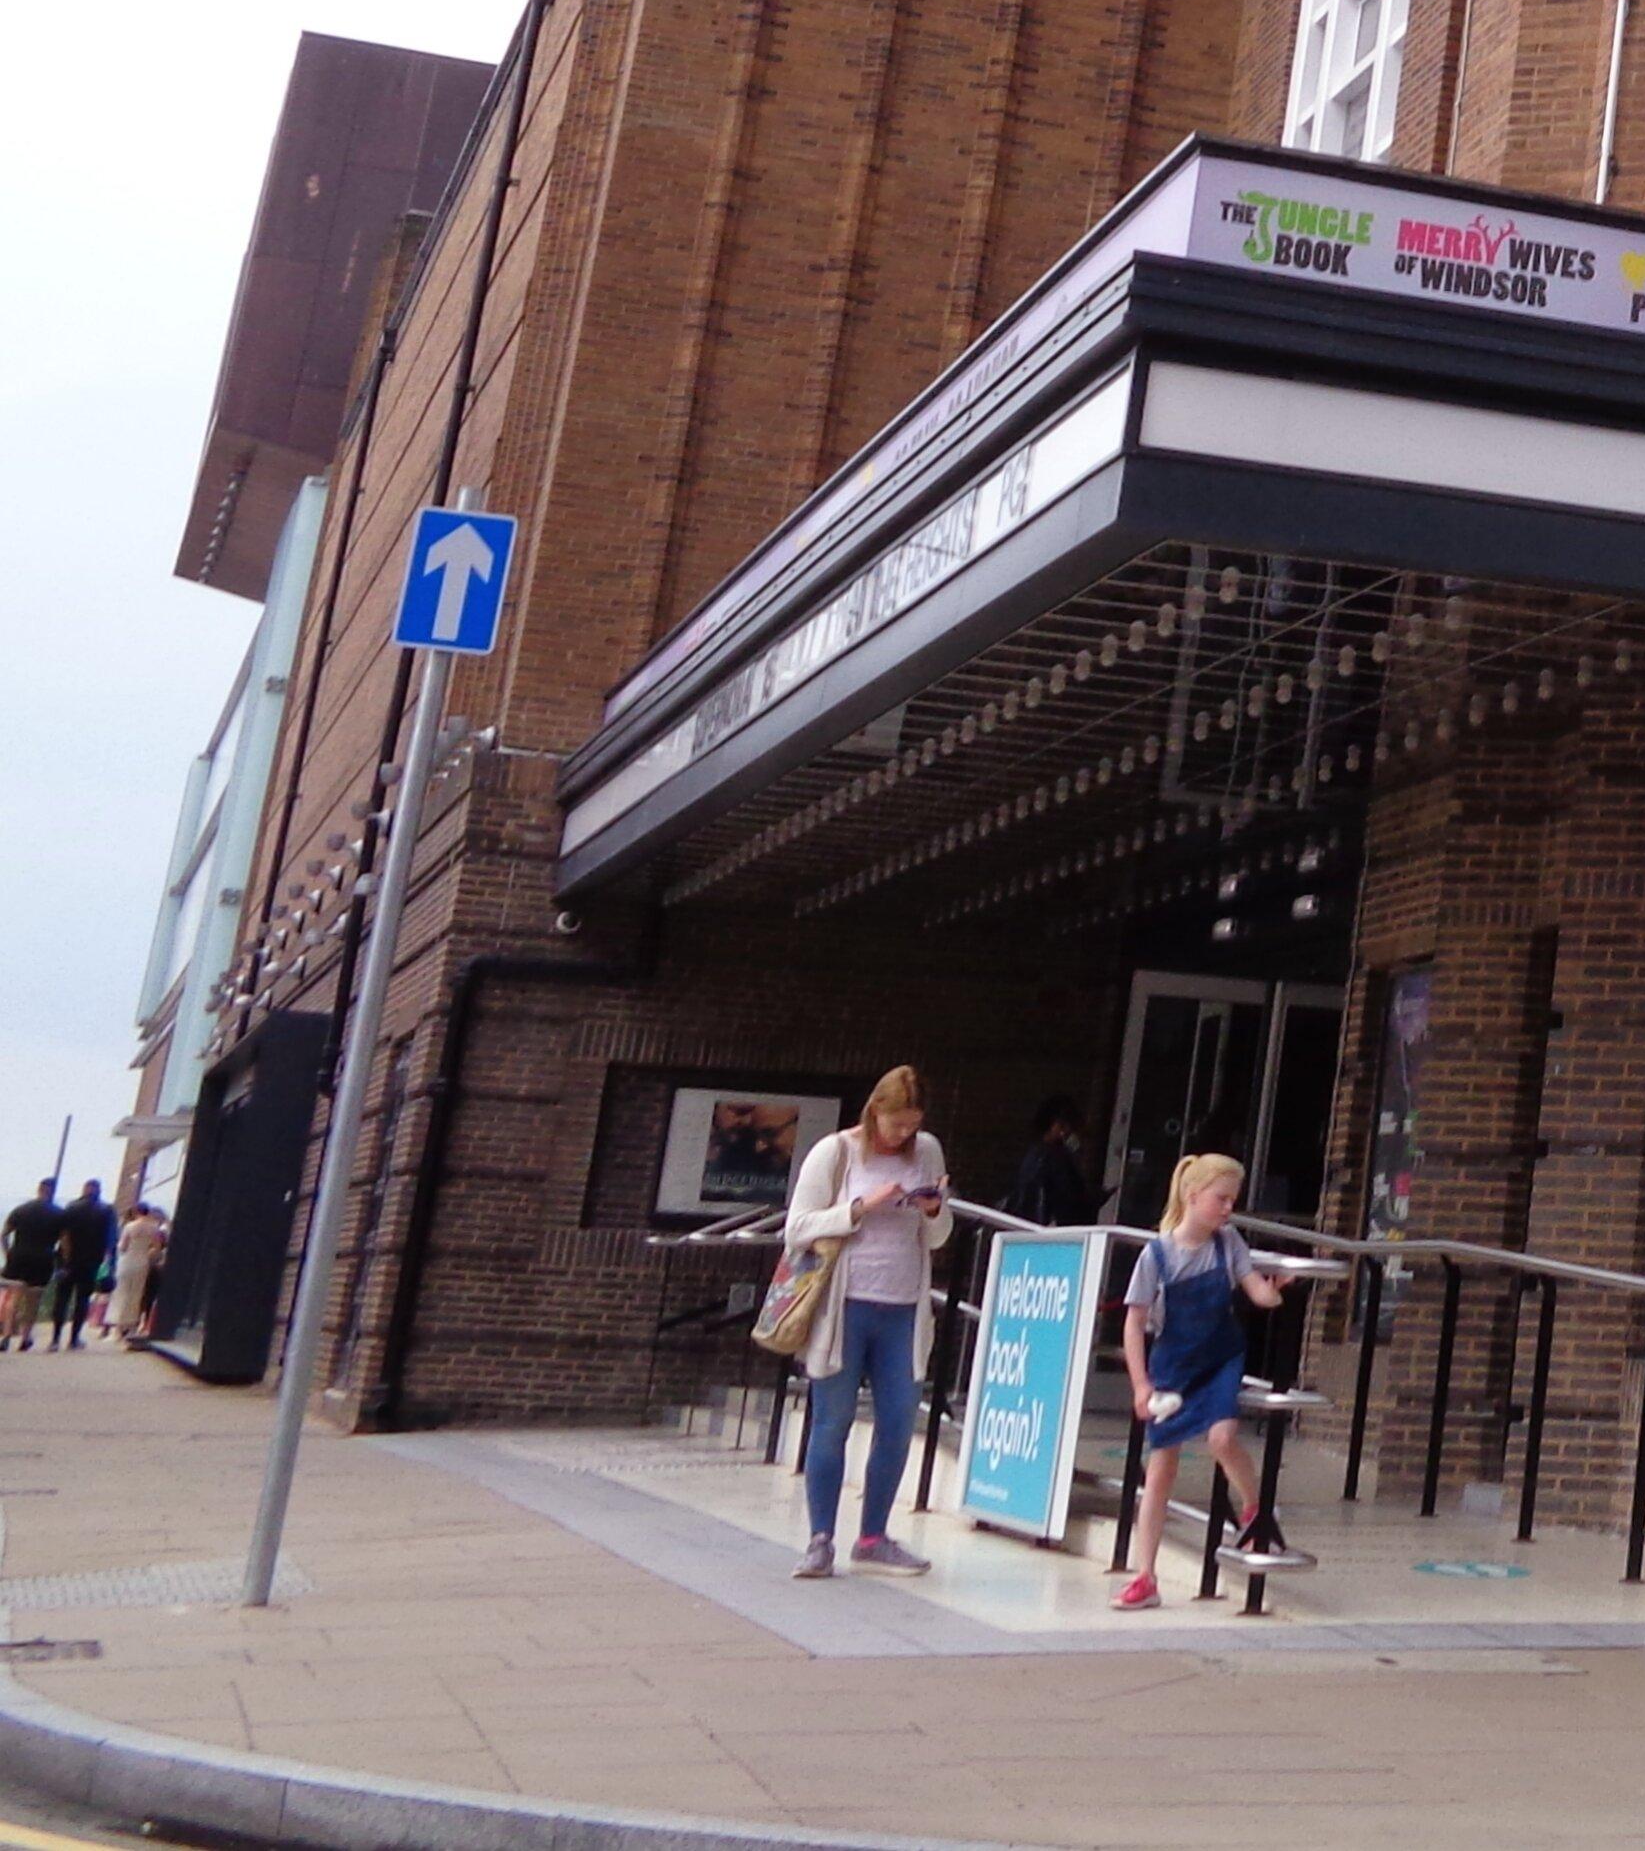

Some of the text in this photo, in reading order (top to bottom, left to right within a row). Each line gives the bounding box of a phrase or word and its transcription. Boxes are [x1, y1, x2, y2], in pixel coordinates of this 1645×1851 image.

[1220, 190, 1375, 263] THE JUNGLE
[1273, 234, 1353, 277] BOOK
[1395, 215, 1597, 281] MERRY WIVES
[1394, 253, 1547, 307] OF WINDSOR
[997, 1258, 1070, 1323] welcome
[986, 1324, 1030, 1387] back
[977, 1391, 1045, 1472] (again)!
